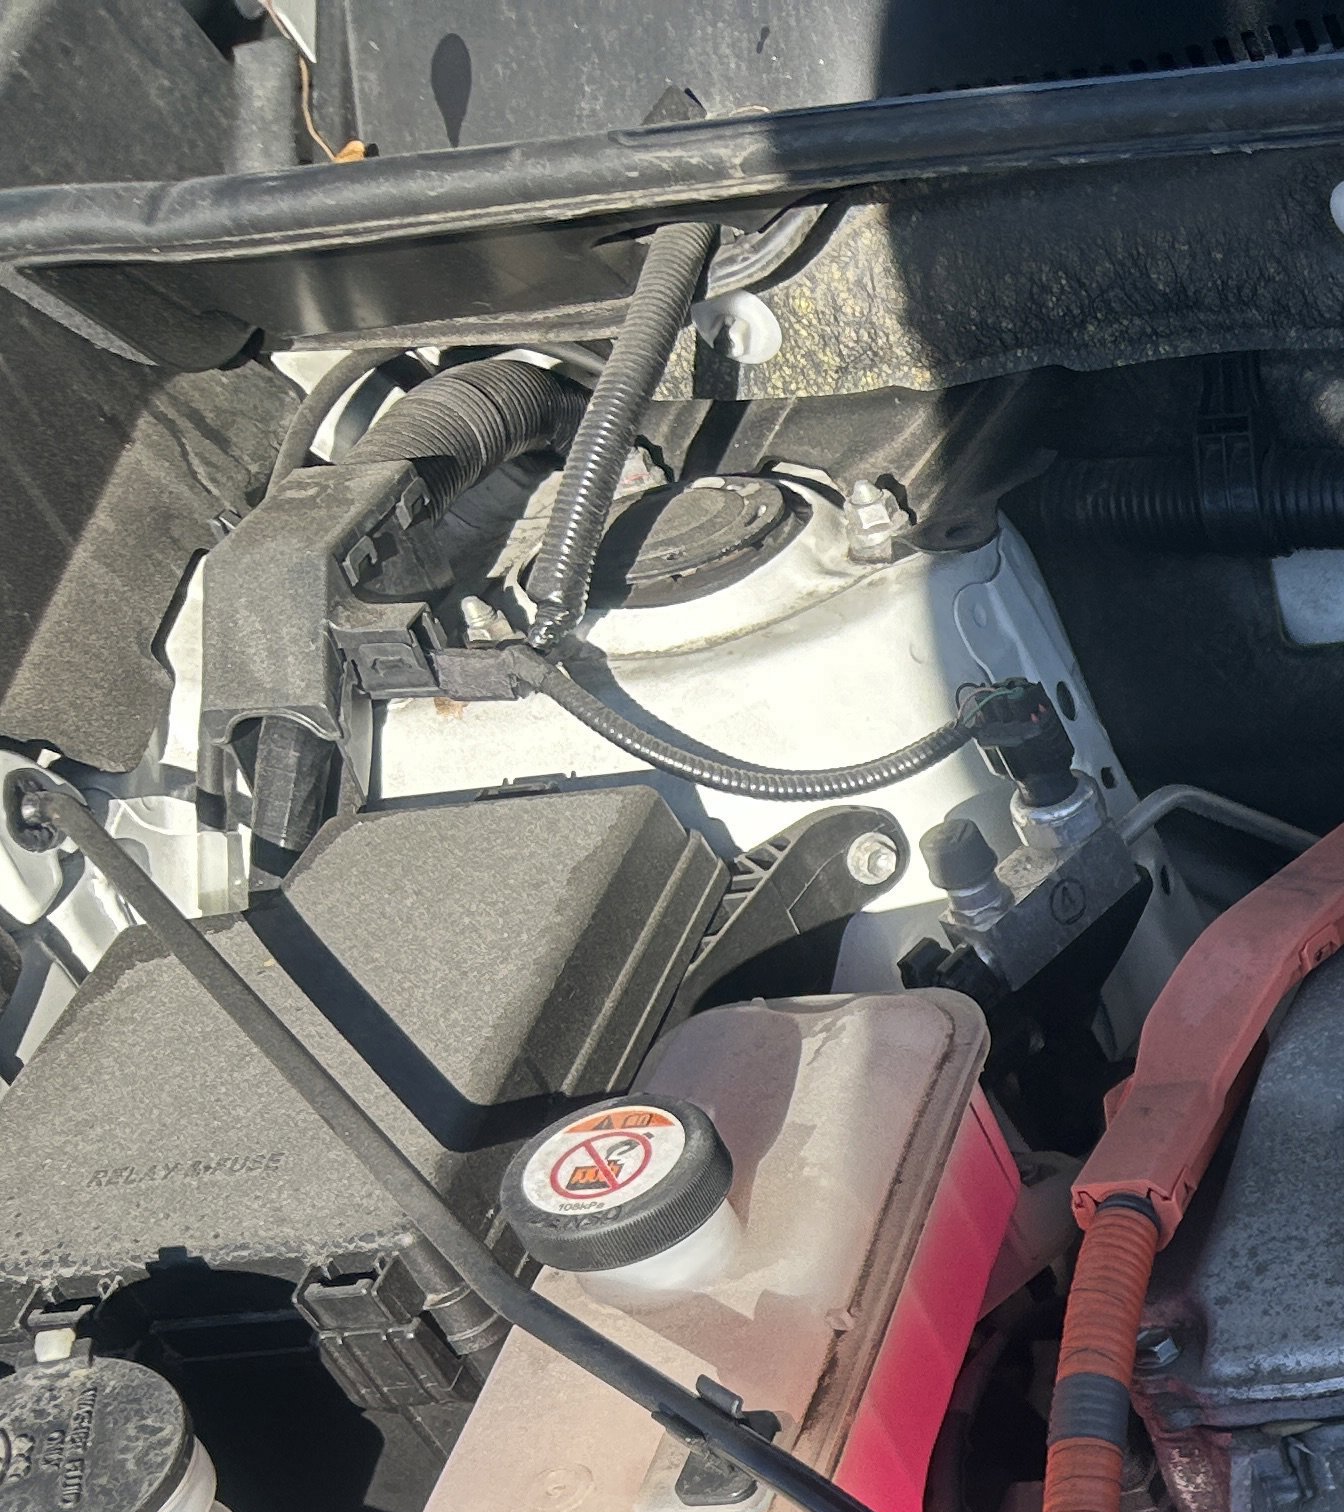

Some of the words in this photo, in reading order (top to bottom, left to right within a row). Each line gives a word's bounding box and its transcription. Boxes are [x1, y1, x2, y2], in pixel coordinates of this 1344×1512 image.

[86, 1161, 182, 1189] RELAY
[209, 1152, 286, 1177] FUSE
[559, 1201, 606, 1212] 108kPa
